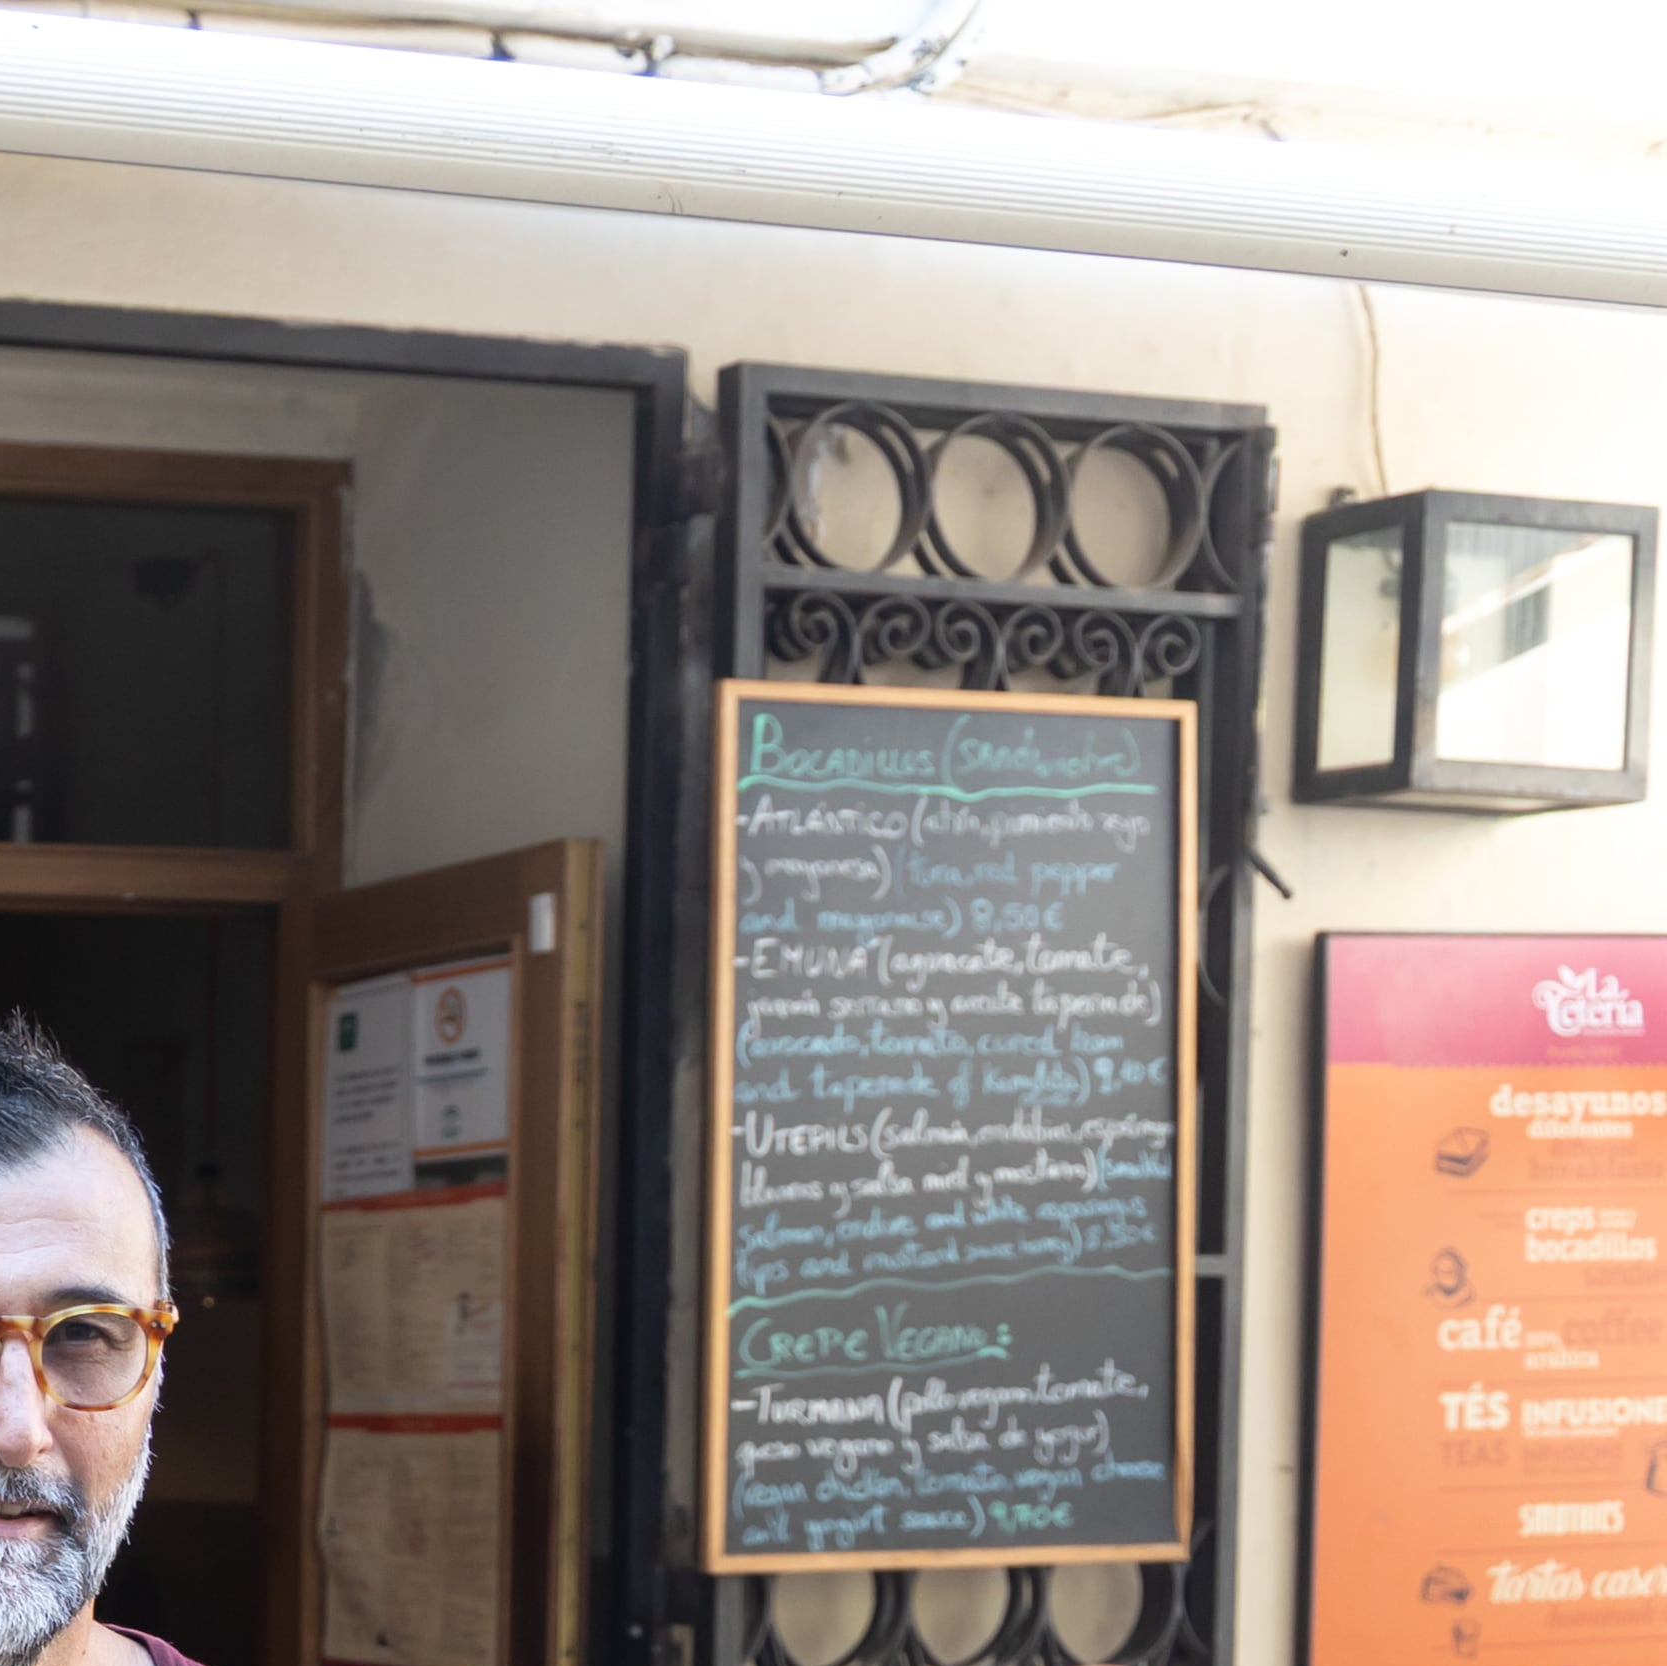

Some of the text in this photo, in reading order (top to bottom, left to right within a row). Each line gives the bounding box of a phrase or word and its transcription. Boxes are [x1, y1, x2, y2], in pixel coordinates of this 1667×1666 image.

[1489, 1082, 1667, 1123] desayunos
[1525, 1206, 1596, 1237] creps
[1524, 1232, 1658, 1262] bocadillos
[1437, 1302, 1523, 1351] café
[1439, 1380, 1511, 1432] TÉS
